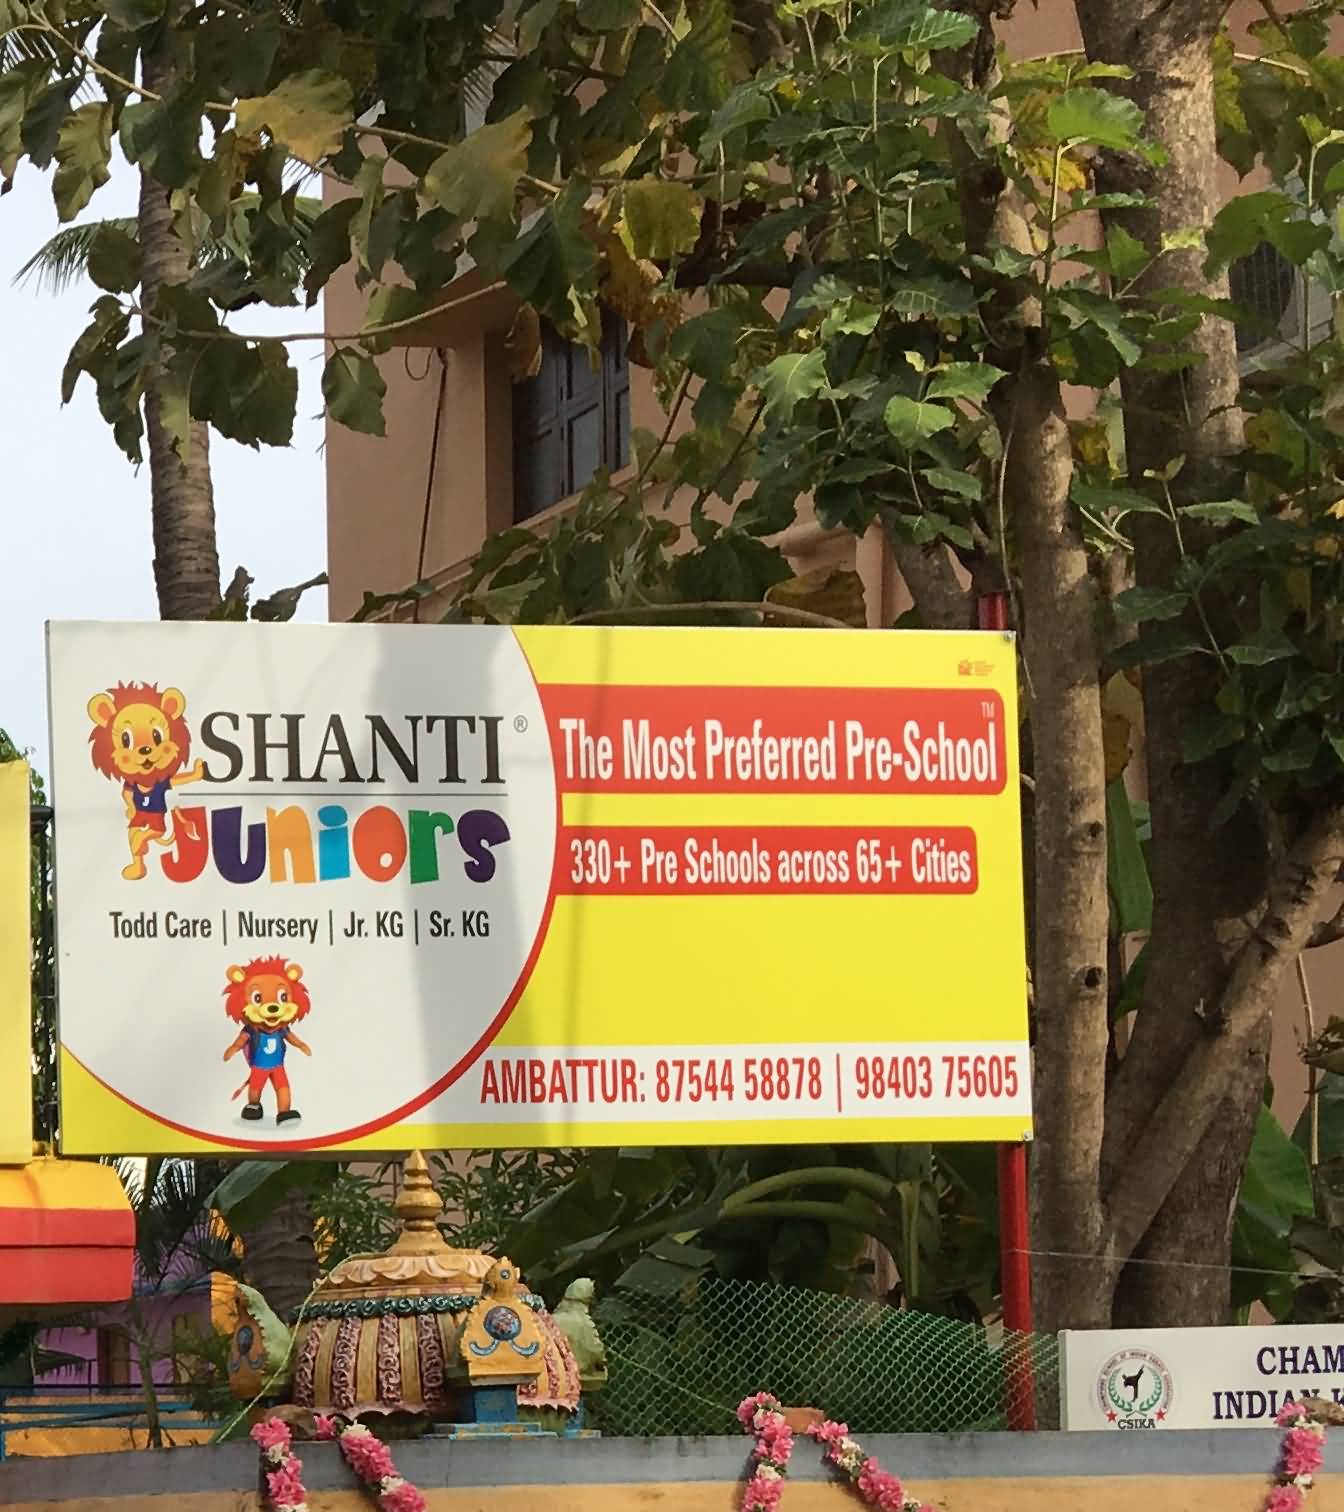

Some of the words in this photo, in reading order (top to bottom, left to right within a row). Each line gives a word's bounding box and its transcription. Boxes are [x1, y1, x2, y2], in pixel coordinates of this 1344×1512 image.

[200, 711, 508, 785] SHANTI
[559, 718, 613, 781] The
[622, 719, 696, 781] Most
[705, 720, 837, 781] Preferred
[845, 720, 997, 782] Pre-School
[570, 838, 631, 884] 330+
[640, 839, 678, 884] Pre
[684, 838, 771, 884] Schools
[778, 849, 850, 884] across
[855, 838, 902, 883] 65+
[911, 838, 971, 883] Cities
[110, 910, 157, 939] Todd
[165, 912, 212, 938] Care
[238, 911, 318, 945] Nursery
[343, 911, 368, 938] Jr.
[376, 911, 404, 938] KG
[429, 910, 455, 938] Sr.
[462, 910, 490, 938] KG
[480, 1058, 646, 1105] AMBATTUR:
[656, 1059, 734, 1102] 87544
[744, 1057, 823, 1101] 58878
[855, 1056, 933, 1100] 98403
[942, 1055, 1018, 1099] 75605
[1118, 1418, 1156, 1430] CSIKA
[1213, 1389, 1320, 1419] INDI
